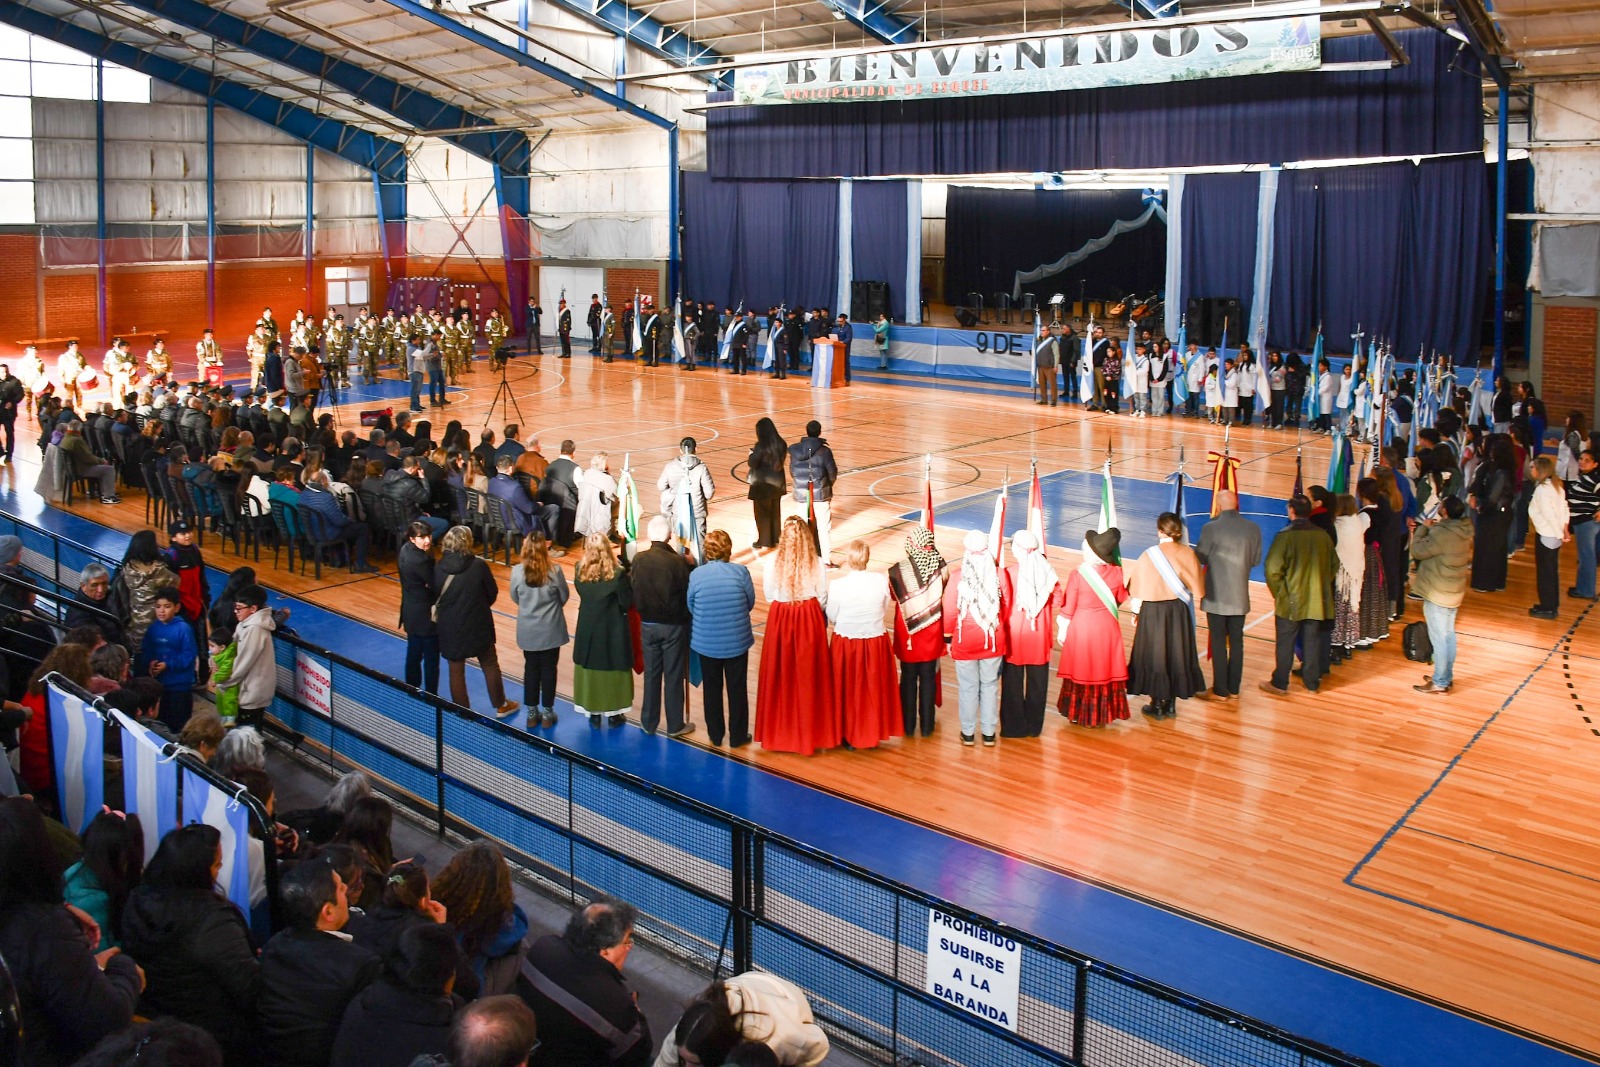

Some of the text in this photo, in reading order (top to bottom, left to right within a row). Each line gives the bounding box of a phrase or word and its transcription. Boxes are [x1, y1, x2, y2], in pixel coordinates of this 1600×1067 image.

[785, 24, 1249, 85] BIENVENIDOS
[1270, 44, 1319, 62] Esquel
[783, 79, 989, 100] MUNICIPALIDAD DE ESQUEL
[976, 332, 1023, 356] 9 DE
[297, 660, 331, 688] PROHIBIDO
[303, 677, 323, 696] SALTAR
[305, 691, 330, 713] BARANDA
[933, 911, 1016, 952] PROHIBIDO
[940, 938, 1004, 974] SUBIRSE
[952, 968, 991, 993] A LA
[934, 983, 1009, 1025] BARANDA
